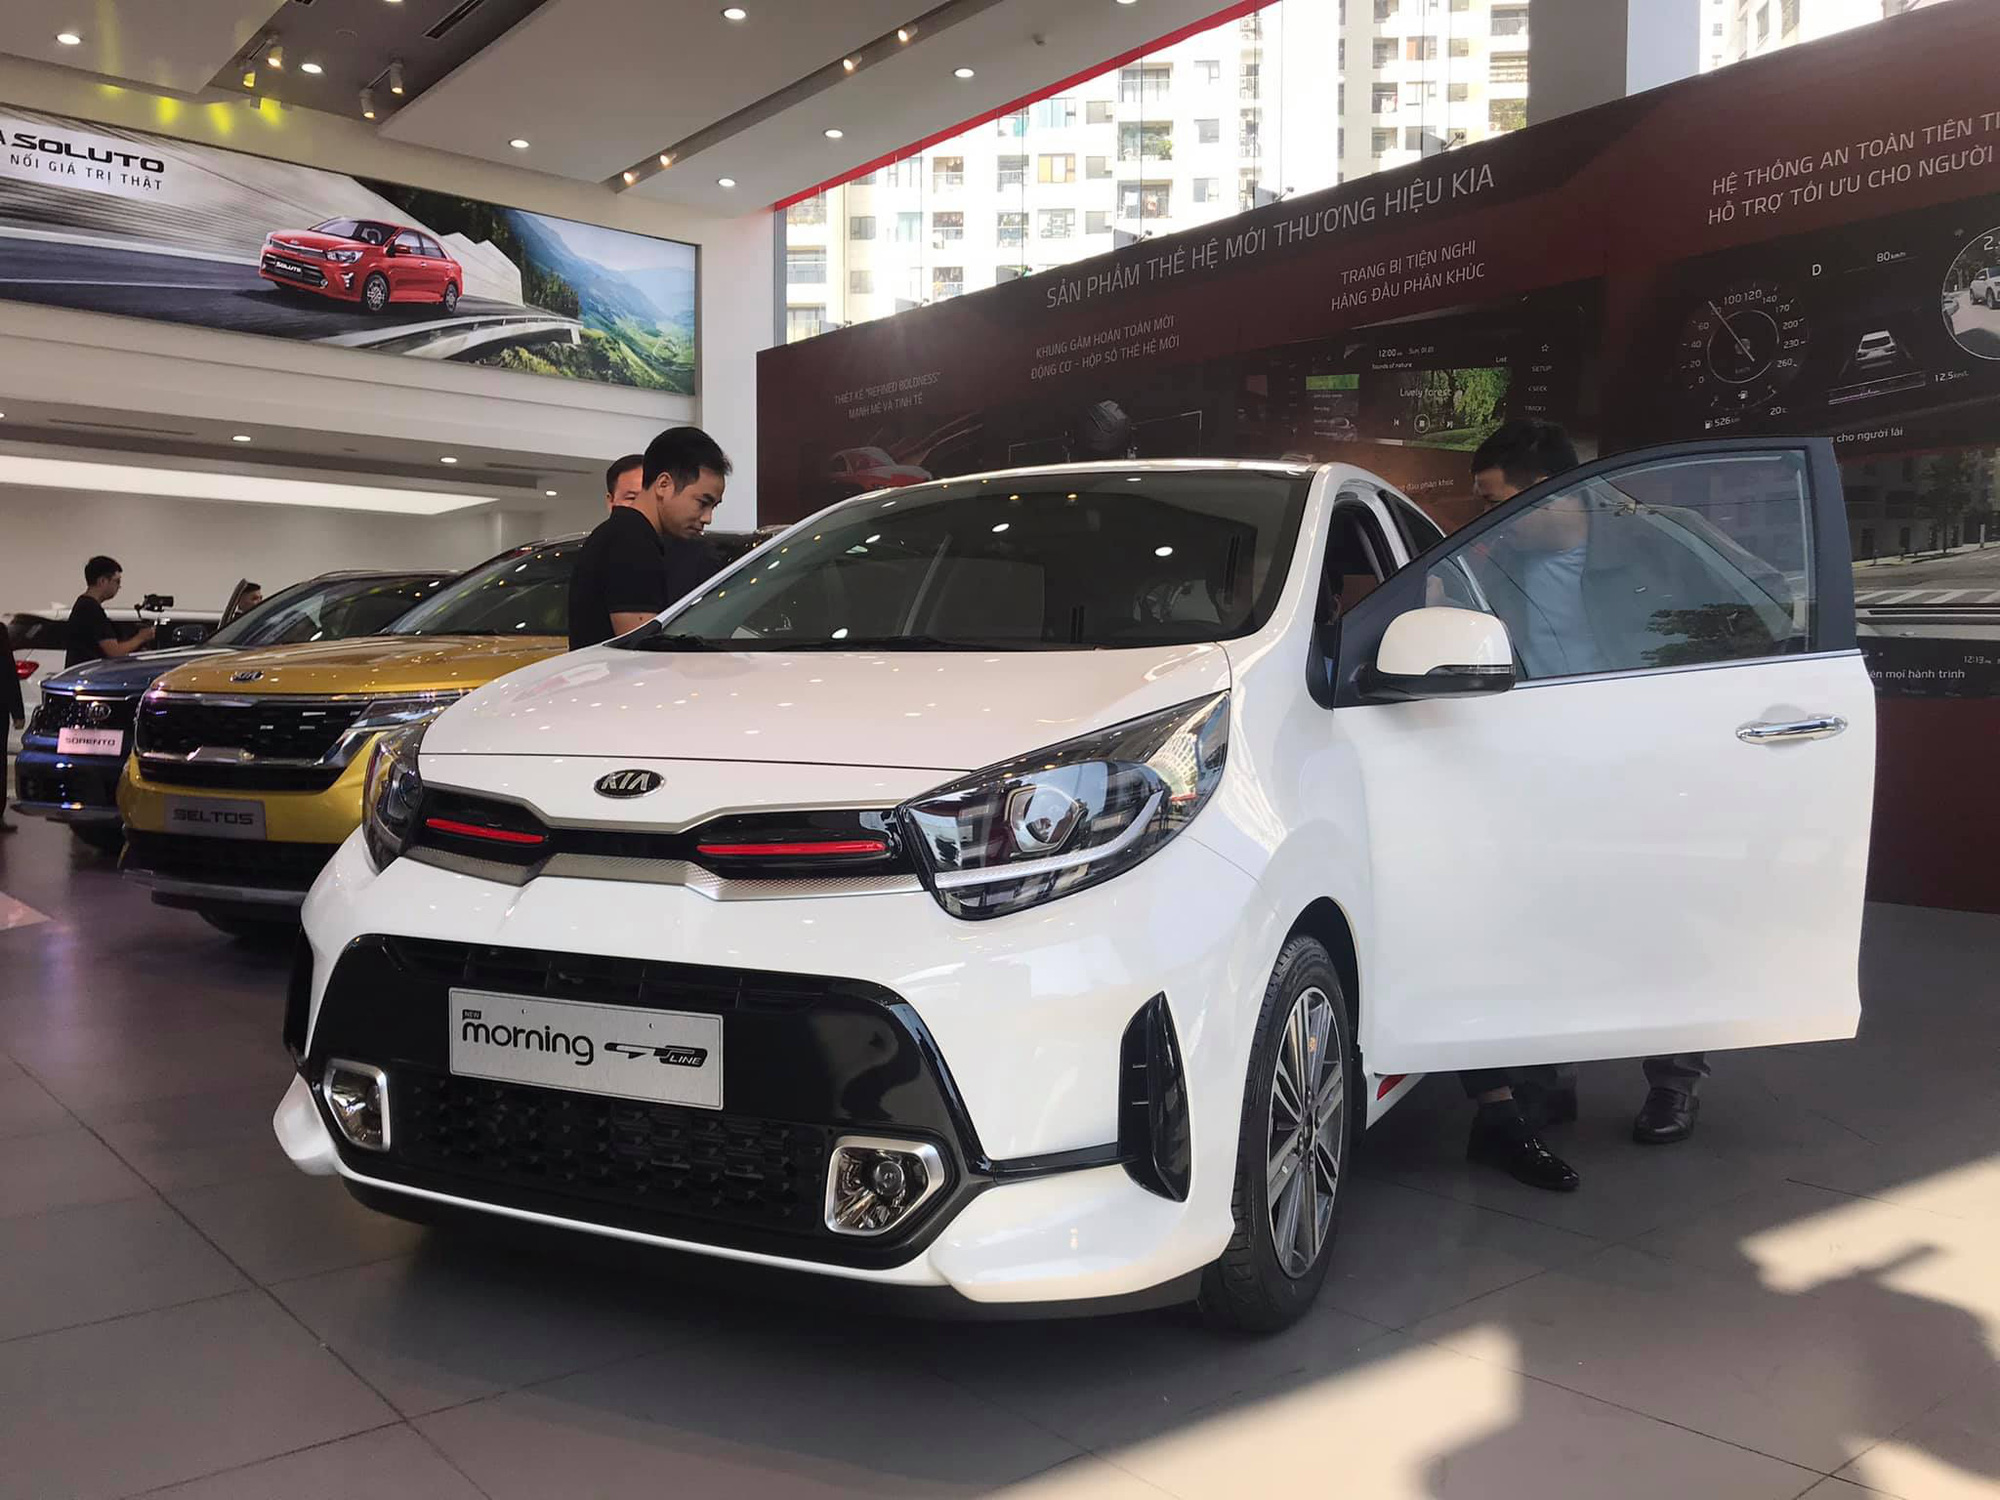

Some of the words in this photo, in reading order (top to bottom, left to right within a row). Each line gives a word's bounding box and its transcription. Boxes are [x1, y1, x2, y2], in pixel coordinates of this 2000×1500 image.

[11, 133, 165, 174] SOLUTO
[1713, 172, 1738, 194] HỆ
[1744, 158, 1813, 187] THỐNG
[1820, 147, 1849, 169] AN
[1856, 131, 1914, 160] TOÀN
[10, 153, 39, 168] NỐI
[48, 160, 76, 175] GIÁ
[86, 167, 111, 184] TRỊ
[120, 174, 162, 191] THẬT
[1742, 192, 1784, 216] TRỢ
[1790, 180, 1822, 206] TỐI
[1830, 174, 1860, 196] ƯU
[1868, 164, 1911, 188] CHO
[1919, 144, 1992, 178] NGƯỜI
[1046, 278, 1081, 308] SẢN
[1147, 245, 1186, 281] THẾ
[1192, 238, 1219, 270] HỆ
[1225, 225, 1266, 261] MỚI
[1274, 197, 1376, 246] THƯƠNG
[1384, 177, 1442, 216] HIỆU
[1452, 163, 1494, 198] KIA
[1984, 235, 2000, 250] 2.
[1341, 262, 1385, 285] TRANG
[1390, 258, 1402, 274] BỊ
[1406, 250, 1437, 269] TIỆN
[1441, 240, 1476, 262] NGHI
[1812, 264, 1822, 276] D
[1331, 293, 1367, 311] HÀNG
[1446, 262, 1485, 285] KHÚC
[1724, 294, 1742, 306] 100
[1744, 289, 1762, 302] 120
[1776, 304, 1790, 313] 170
[1698, 322, 1710, 330] 60
[1782, 320, 1798, 330] 200
[1036, 342, 1068, 360] KHUNG
[1094, 328, 1121, 345] HOÀN
[1124, 320, 1150, 338] TOÀN
[1691, 340, 1702, 348] 40
[1784, 339, 1799, 349] 230
[1031, 364, 1056, 380] ĐỘNG
[1082, 353, 1101, 368] HỘP
[1690, 360, 1701, 368] 20
[1777, 358, 1792, 368] 260
[1836, 433, 1854, 444] cho
[1857, 428, 1888, 442] người
[1890, 426, 1903, 437] lái
[1886, 669, 1906, 680] mọi
[1908, 669, 1935, 678] hành
[1938, 669, 1965, 678] trình
[66, 736, 116, 746] SORENTO
[600, 771, 652, 792] KIA
[172, 808, 254, 825] SELTOS
[463, 1010, 481, 1019] NEW
[462, 1022, 594, 1066] morning
[668, 1054, 702, 1066] LINE
